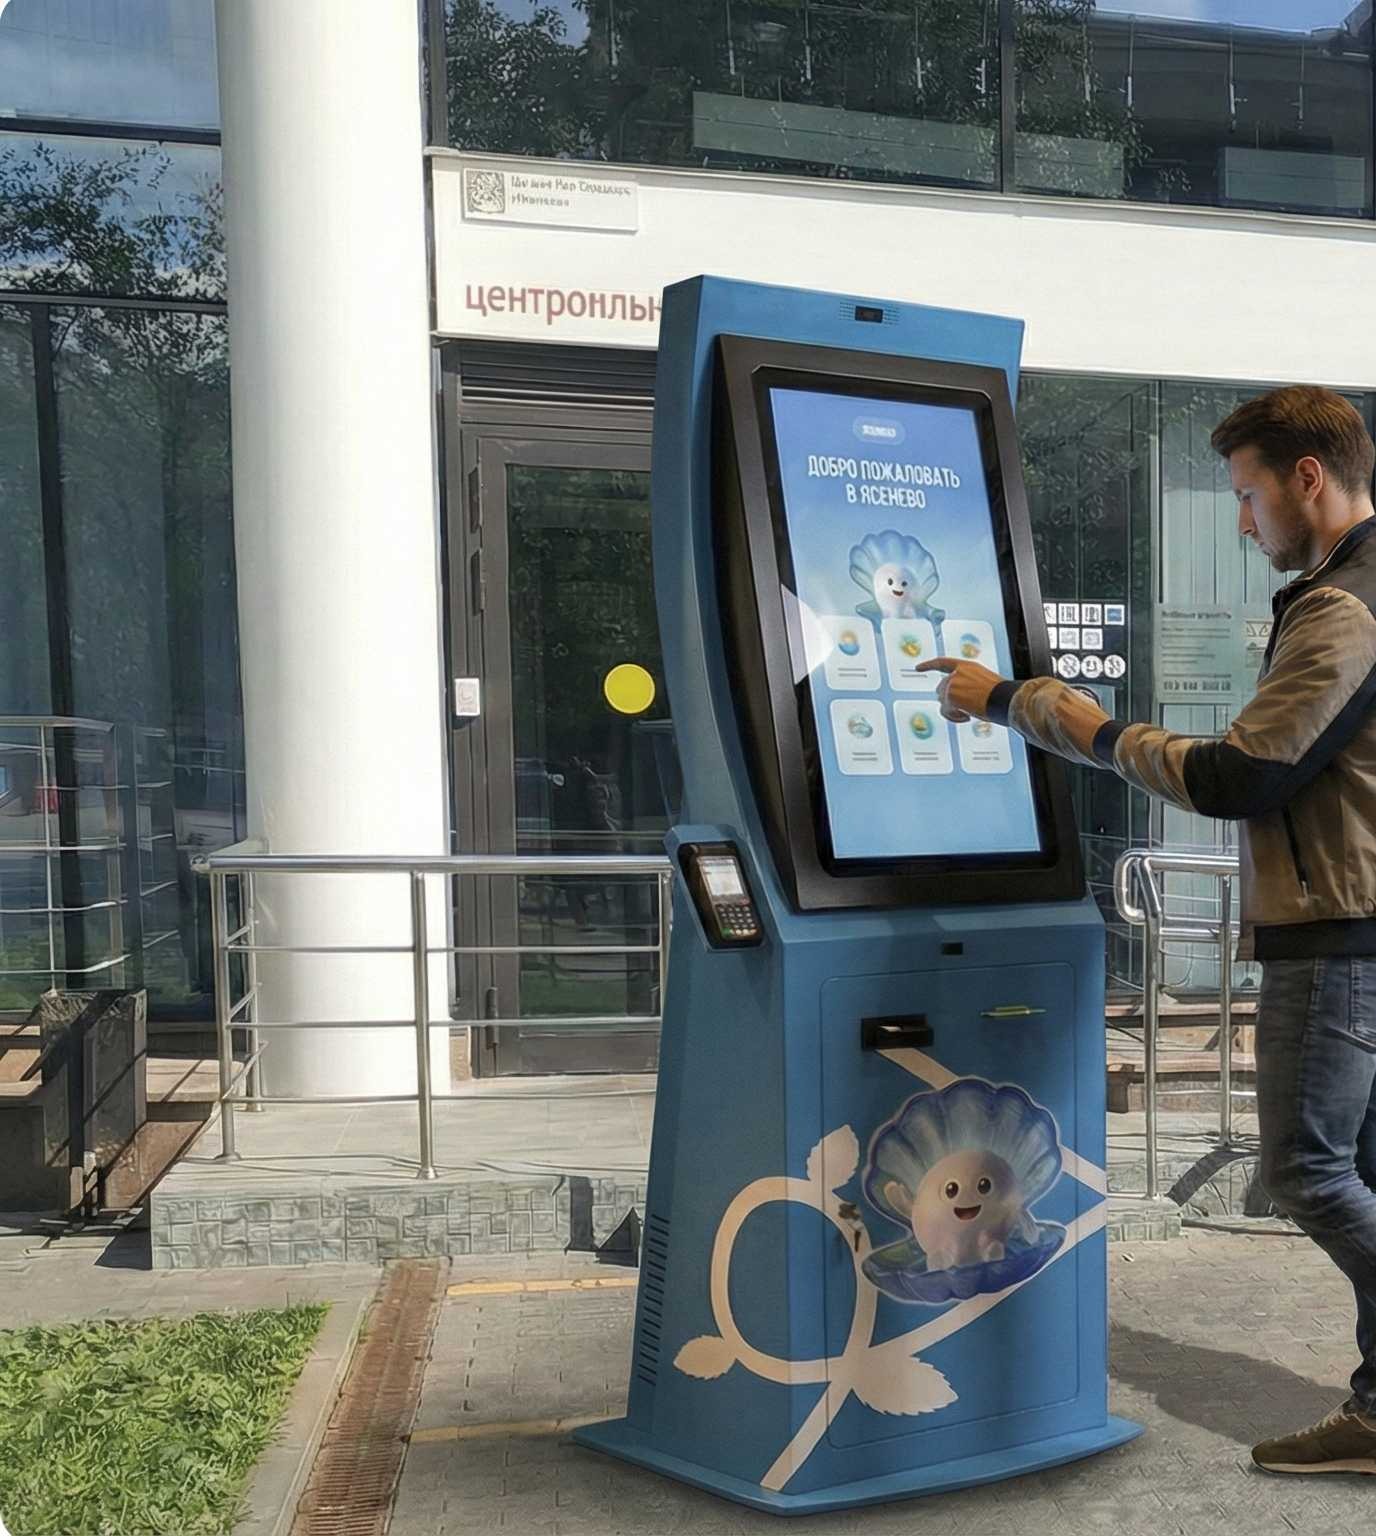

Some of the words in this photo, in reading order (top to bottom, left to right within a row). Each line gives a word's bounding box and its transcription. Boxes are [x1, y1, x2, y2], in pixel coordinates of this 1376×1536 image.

[808, 455, 857, 479] ДОБРО
[861, 460, 960, 488] ПОЖАЛОВАТЬ
[846, 483, 857, 503] В
[861, 486, 926, 509] ЯСЕНЕВО
